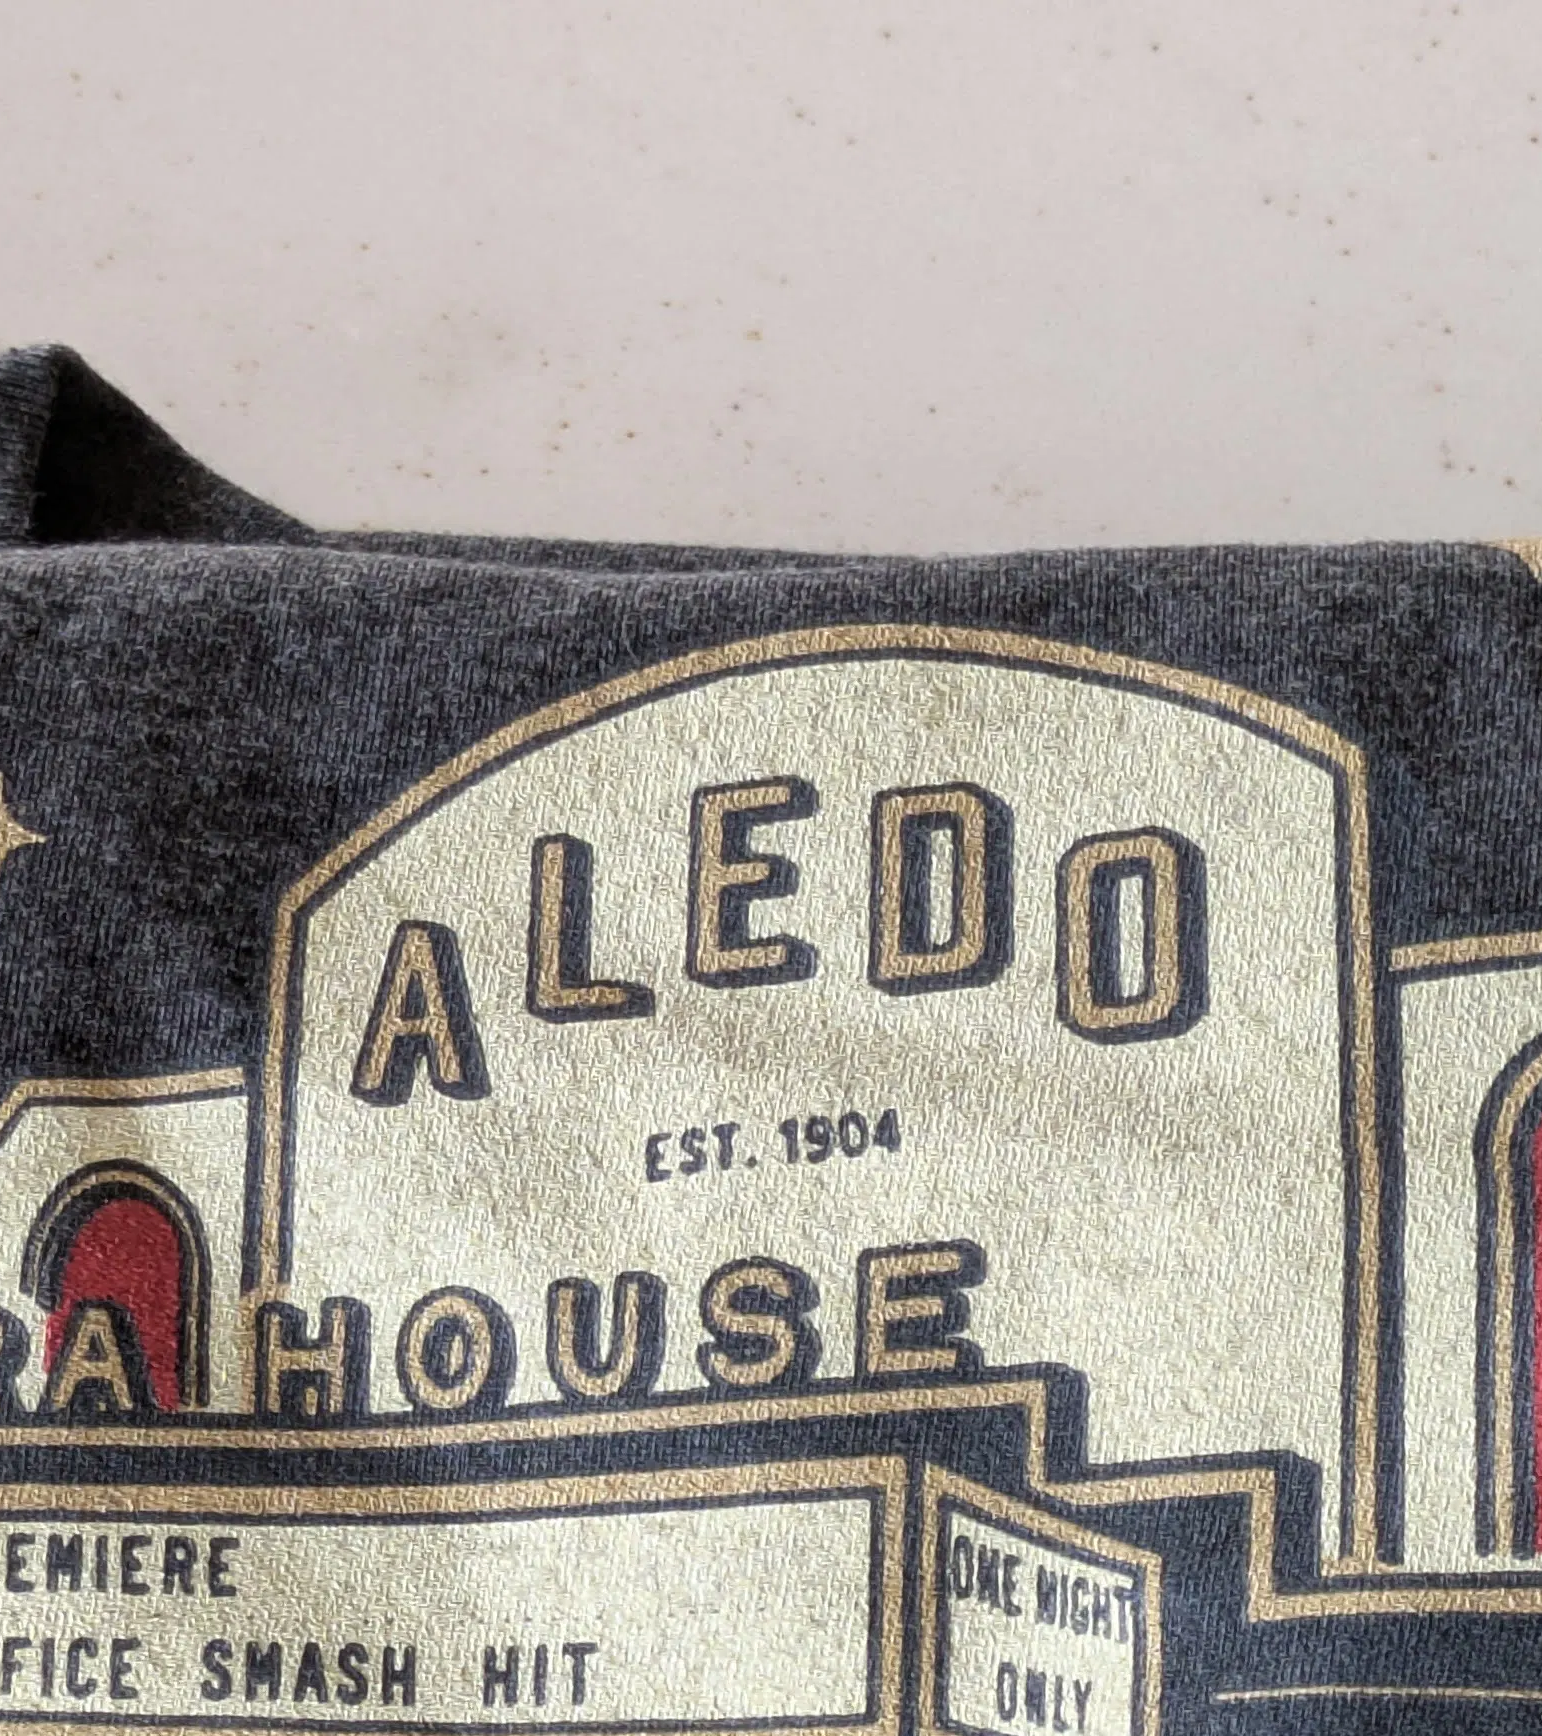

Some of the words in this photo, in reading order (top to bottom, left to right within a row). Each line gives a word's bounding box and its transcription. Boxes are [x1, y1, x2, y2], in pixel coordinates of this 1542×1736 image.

[349, 774, 1209, 1105] ALEDO
[644, 1120, 758, 1183] EST.
[779, 1106, 904, 1167] 1904
[262, 1240, 985, 1412] HOUSE
[948, 1534, 1023, 1618] ONE
[1035, 1563, 1135, 1645] NIGHT
[200, 1637, 418, 1707] SMASH
[482, 1641, 600, 1707] HIT
[996, 1661, 1093, 1734] ONLY
